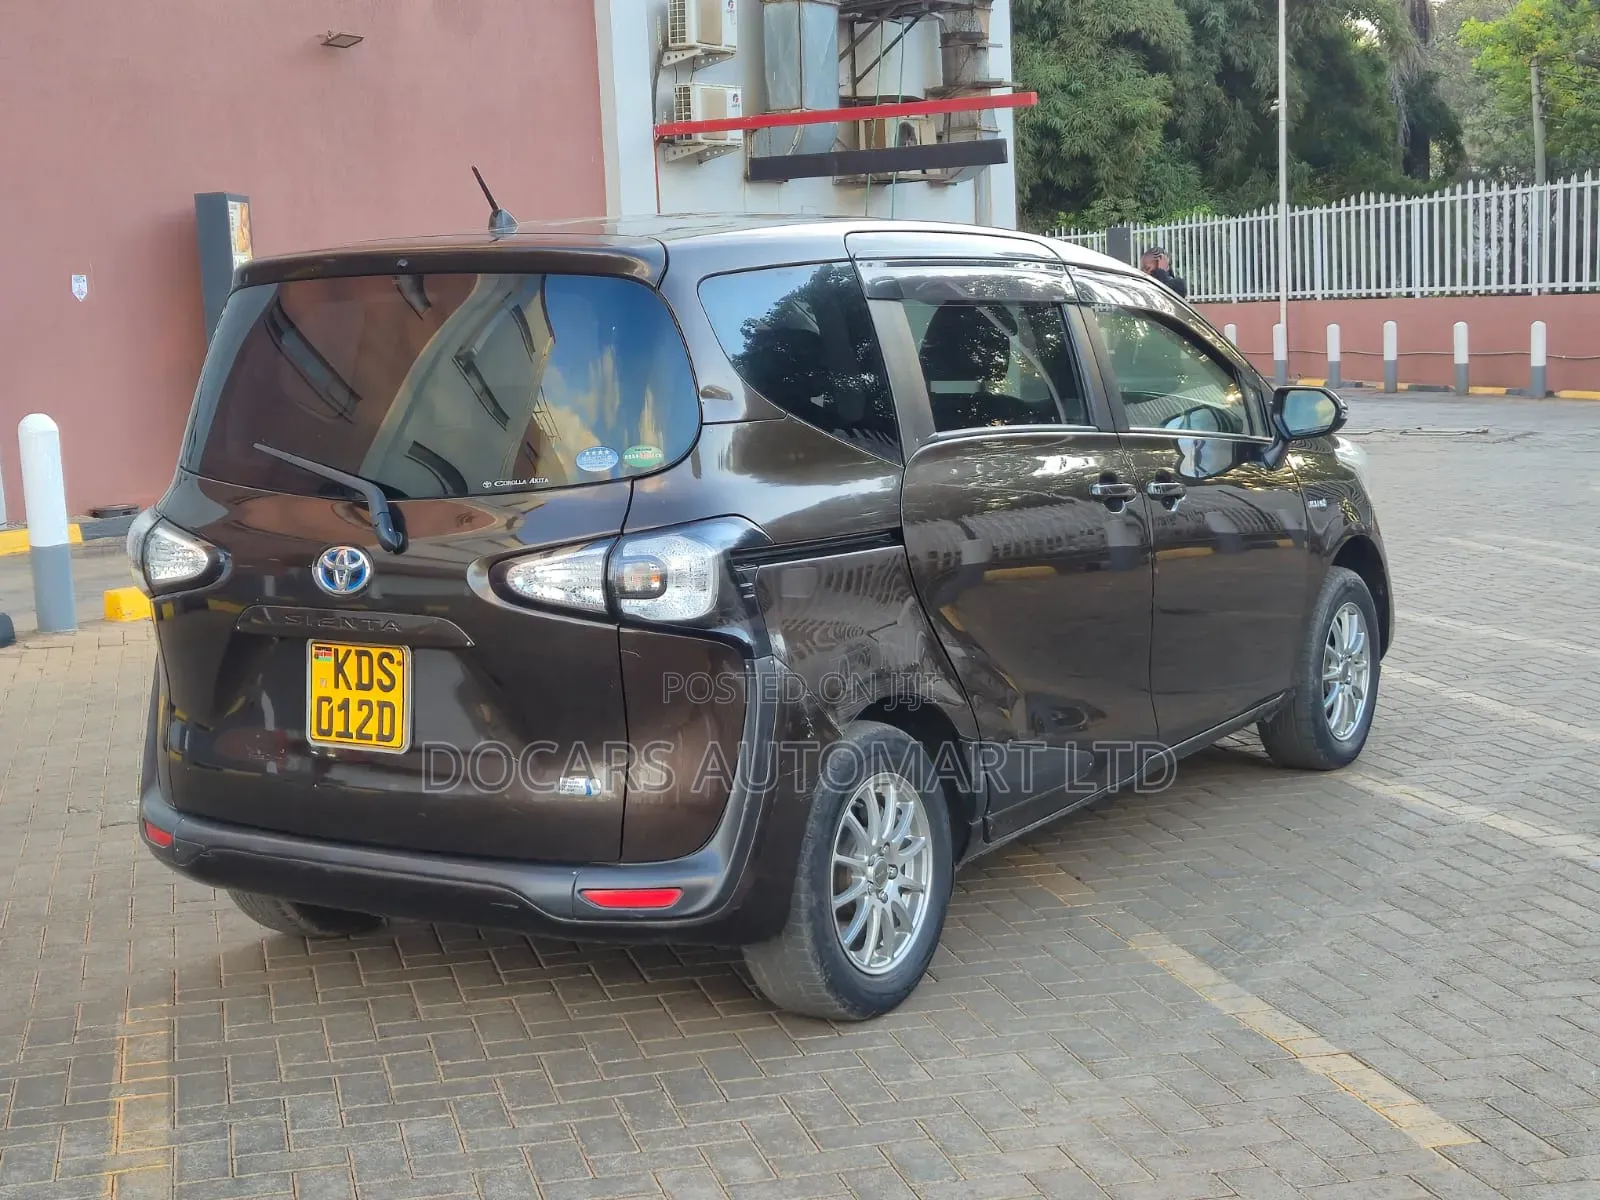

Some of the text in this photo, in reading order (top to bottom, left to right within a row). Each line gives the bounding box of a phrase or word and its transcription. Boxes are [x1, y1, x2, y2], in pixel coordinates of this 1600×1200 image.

[285, 615, 402, 632] SIENTA
[333, 647, 397, 693] KDS
[316, 696, 396, 743] 012D
